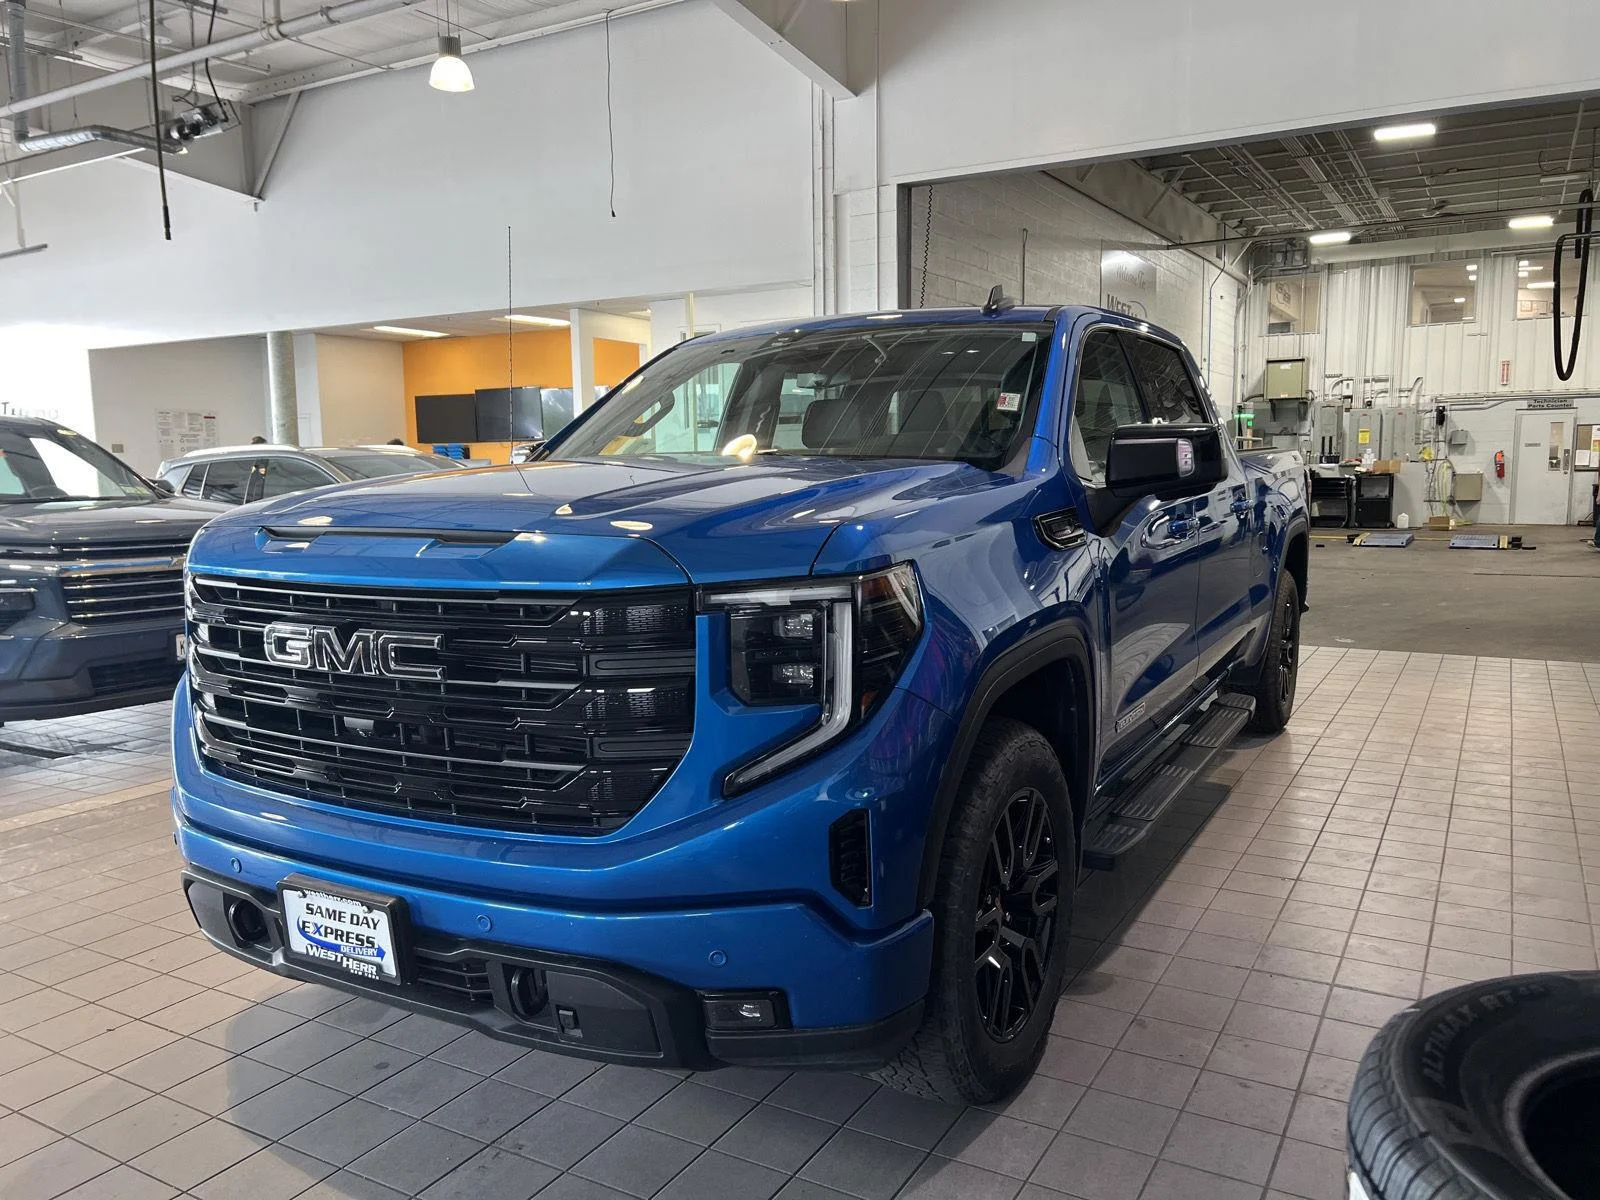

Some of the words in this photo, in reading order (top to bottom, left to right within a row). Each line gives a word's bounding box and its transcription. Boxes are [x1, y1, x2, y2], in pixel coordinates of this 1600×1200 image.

[264, 621, 446, 681] GMC
[305, 902, 347, 923] SAME
[350, 912, 380, 931] DAY
[301, 920, 376, 949] EXPRESS
[340, 945, 378, 957] DELIVERY
